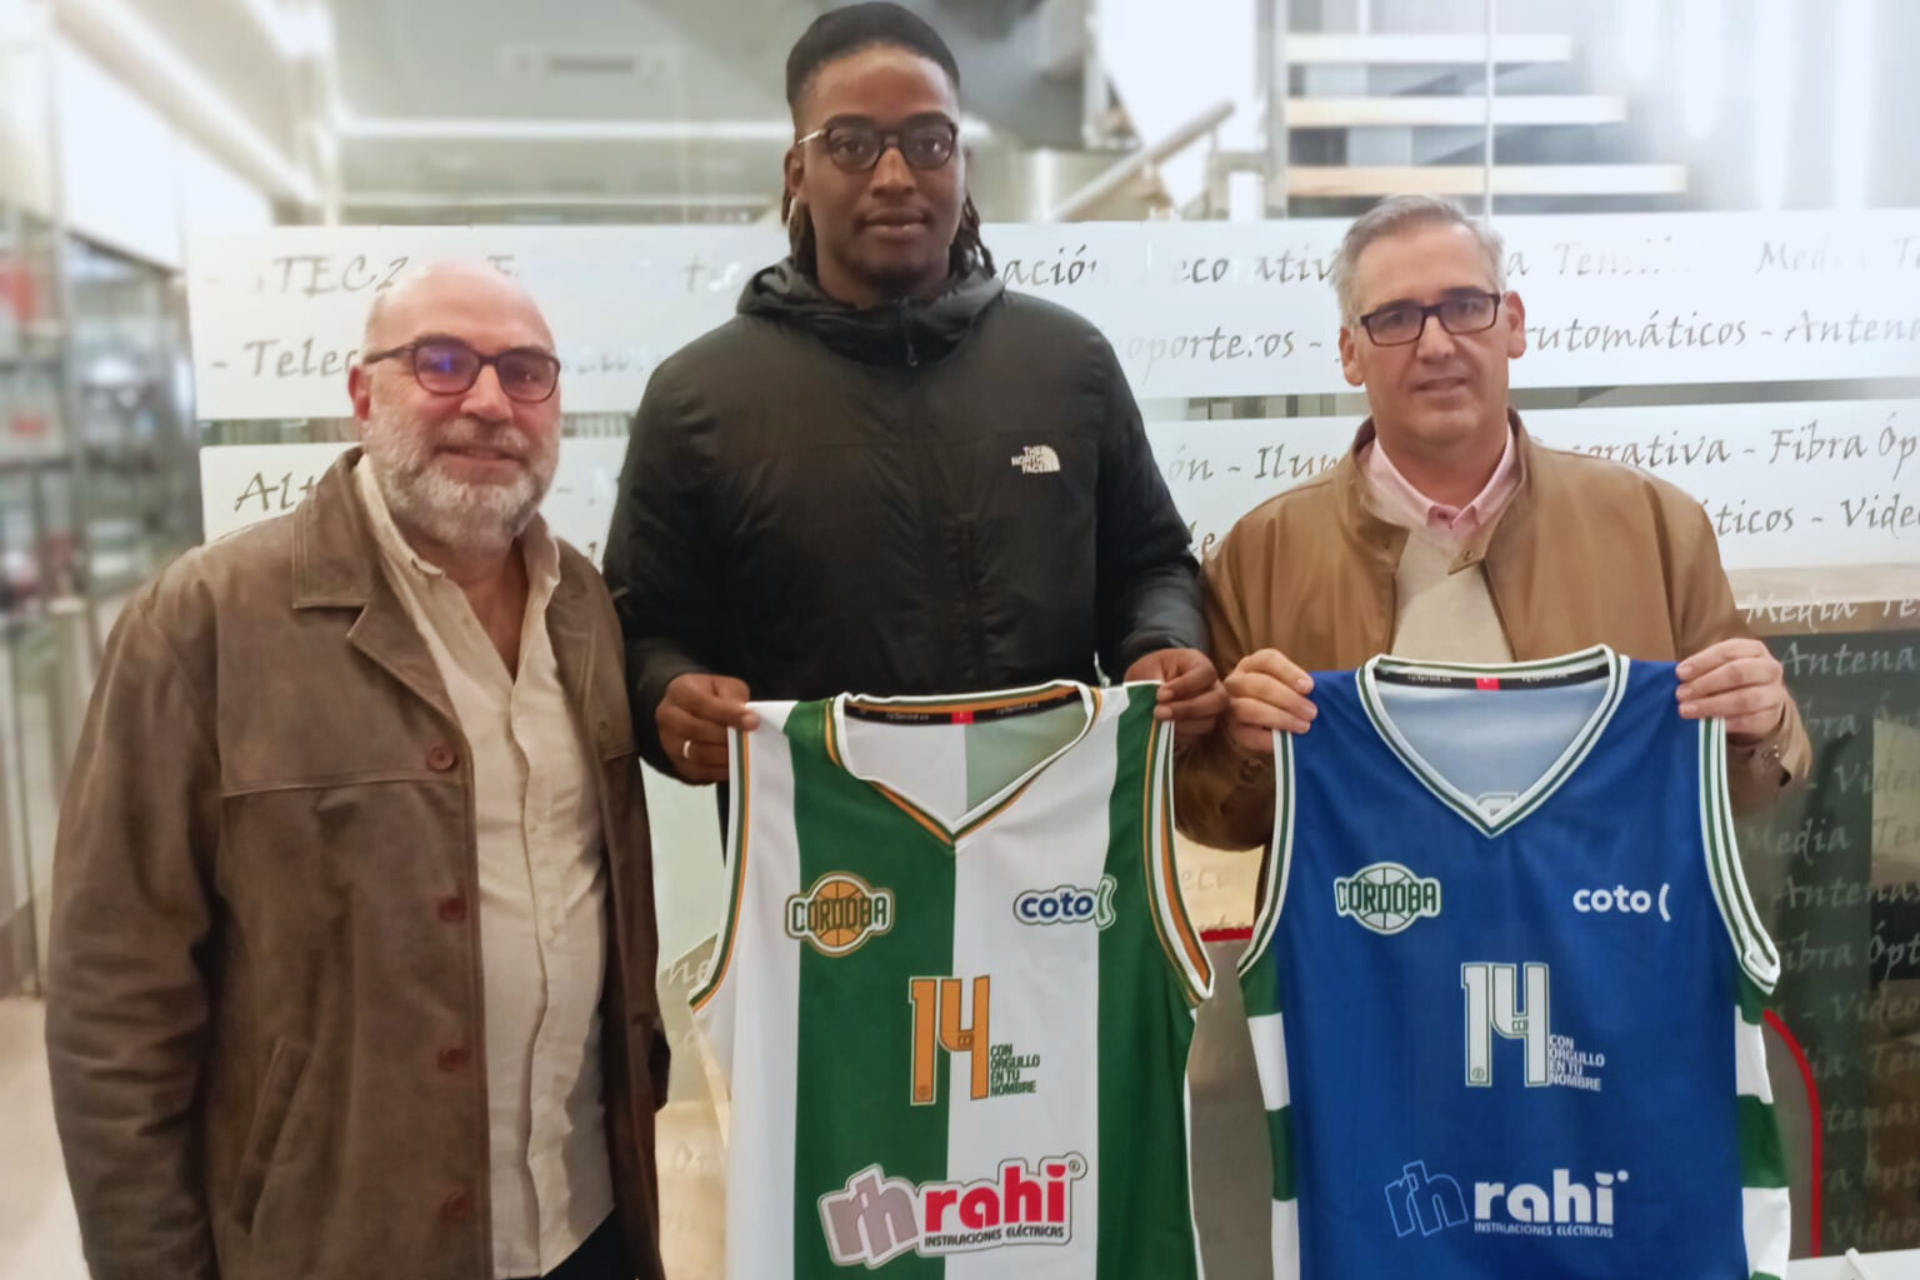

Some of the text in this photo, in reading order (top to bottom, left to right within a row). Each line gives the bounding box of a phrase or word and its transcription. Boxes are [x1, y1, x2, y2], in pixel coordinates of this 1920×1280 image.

[1769, 420, 1868, 463] Fibra
[1839, 493, 1920, 540] Vide
[908, 974, 990, 1106] 14
[1461, 962, 1550, 1088] 14
[1550, 1034, 1574, 1049] CON
[925, 1164, 1066, 1233] rahi
[1474, 1168, 1615, 1226] rahi
[924, 1228, 1002, 1248] INSTALACIONES
[1474, 1222, 1552, 1237] INSTALACIONES
